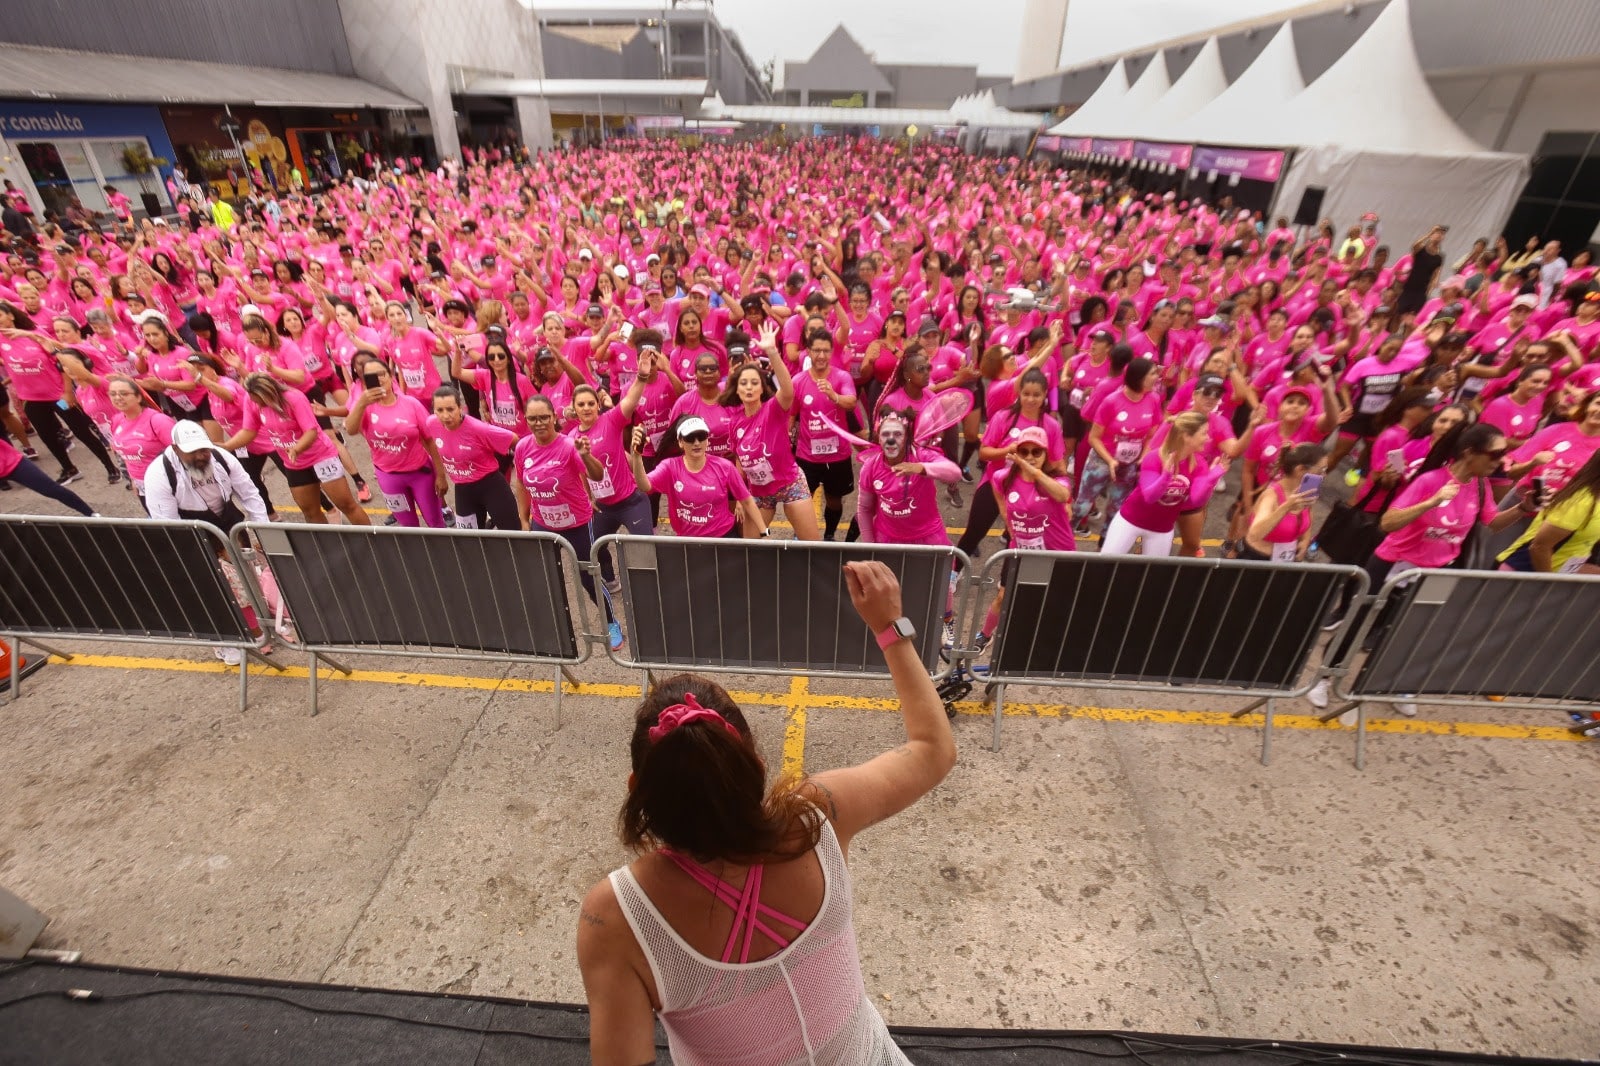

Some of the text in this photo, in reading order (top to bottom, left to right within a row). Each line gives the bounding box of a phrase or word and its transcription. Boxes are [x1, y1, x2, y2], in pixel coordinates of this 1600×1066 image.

[9, 111, 84, 131] consulta
[815, 443, 833, 453] 992
[320, 464, 338, 475] 215
[541, 510, 570, 522] 2829
[691, 515, 708, 523] RUN
